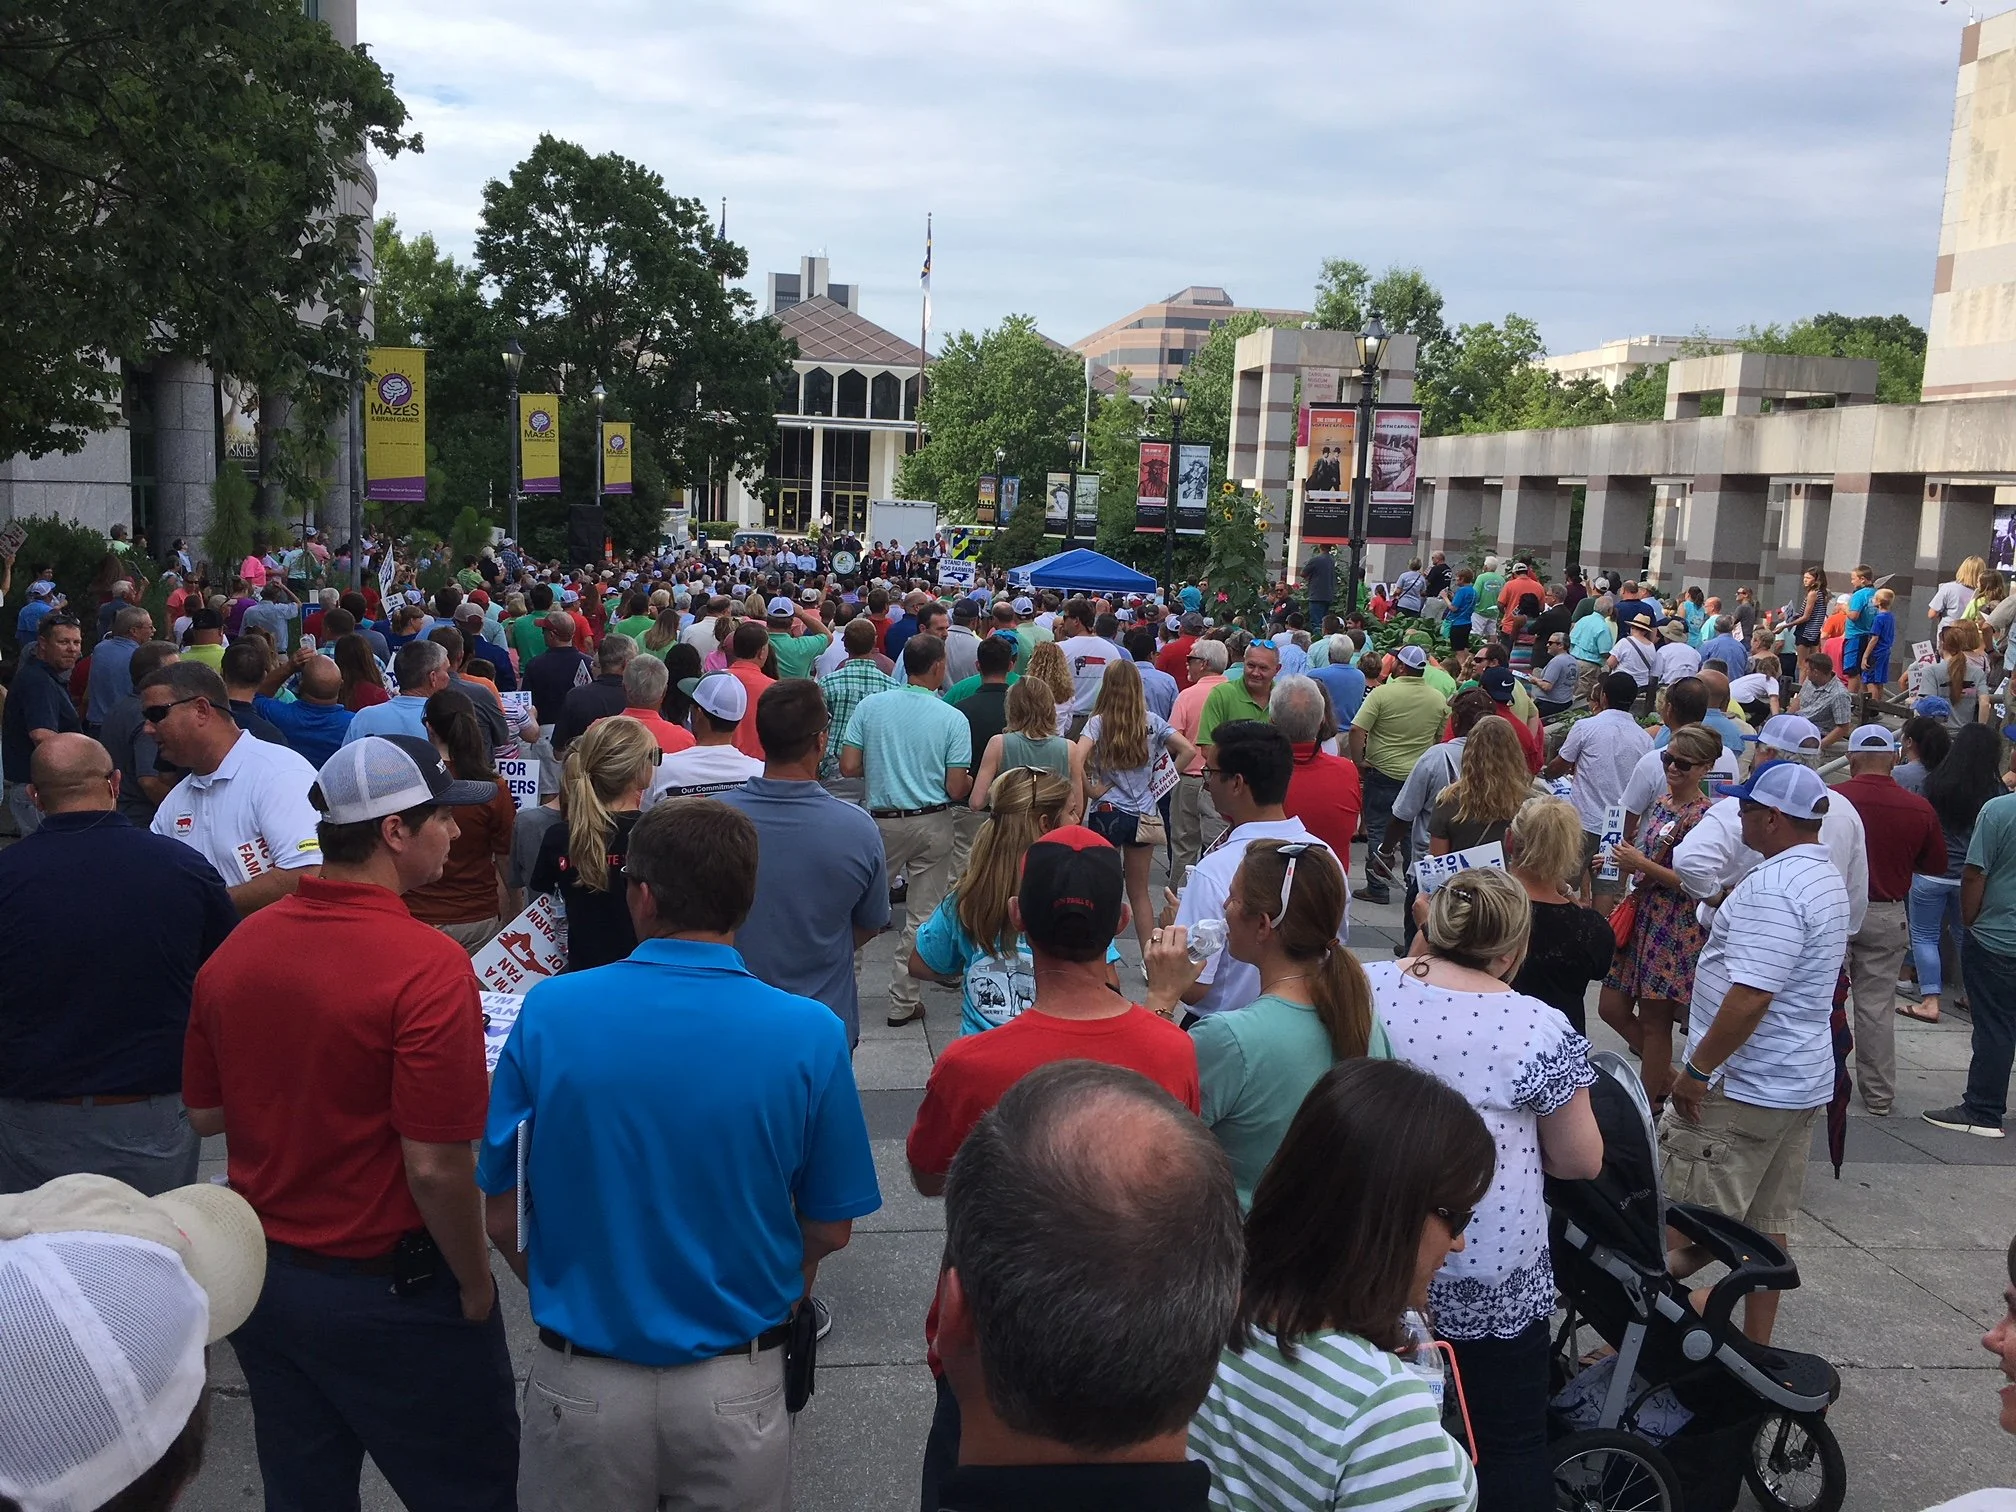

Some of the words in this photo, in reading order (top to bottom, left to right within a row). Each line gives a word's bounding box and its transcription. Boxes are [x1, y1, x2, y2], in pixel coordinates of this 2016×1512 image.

[370, 402, 420, 416] MAZES
[524, 430, 556, 438] MAZES
[230, 443, 255, 458] SKIES
[499, 762, 526, 775] FOR
[1160, 768, 1175, 782] FARM
[1153, 775, 1178, 800] FAMILIES
[255, 835, 269, 859] NC
[1446, 855, 1458, 873] OF
[525, 908, 556, 943] FARM
[545, 954, 564, 970] OF
[484, 966, 497, 978] A
[498, 957, 524, 984] FAN
[484, 995, 514, 1005] I'M
